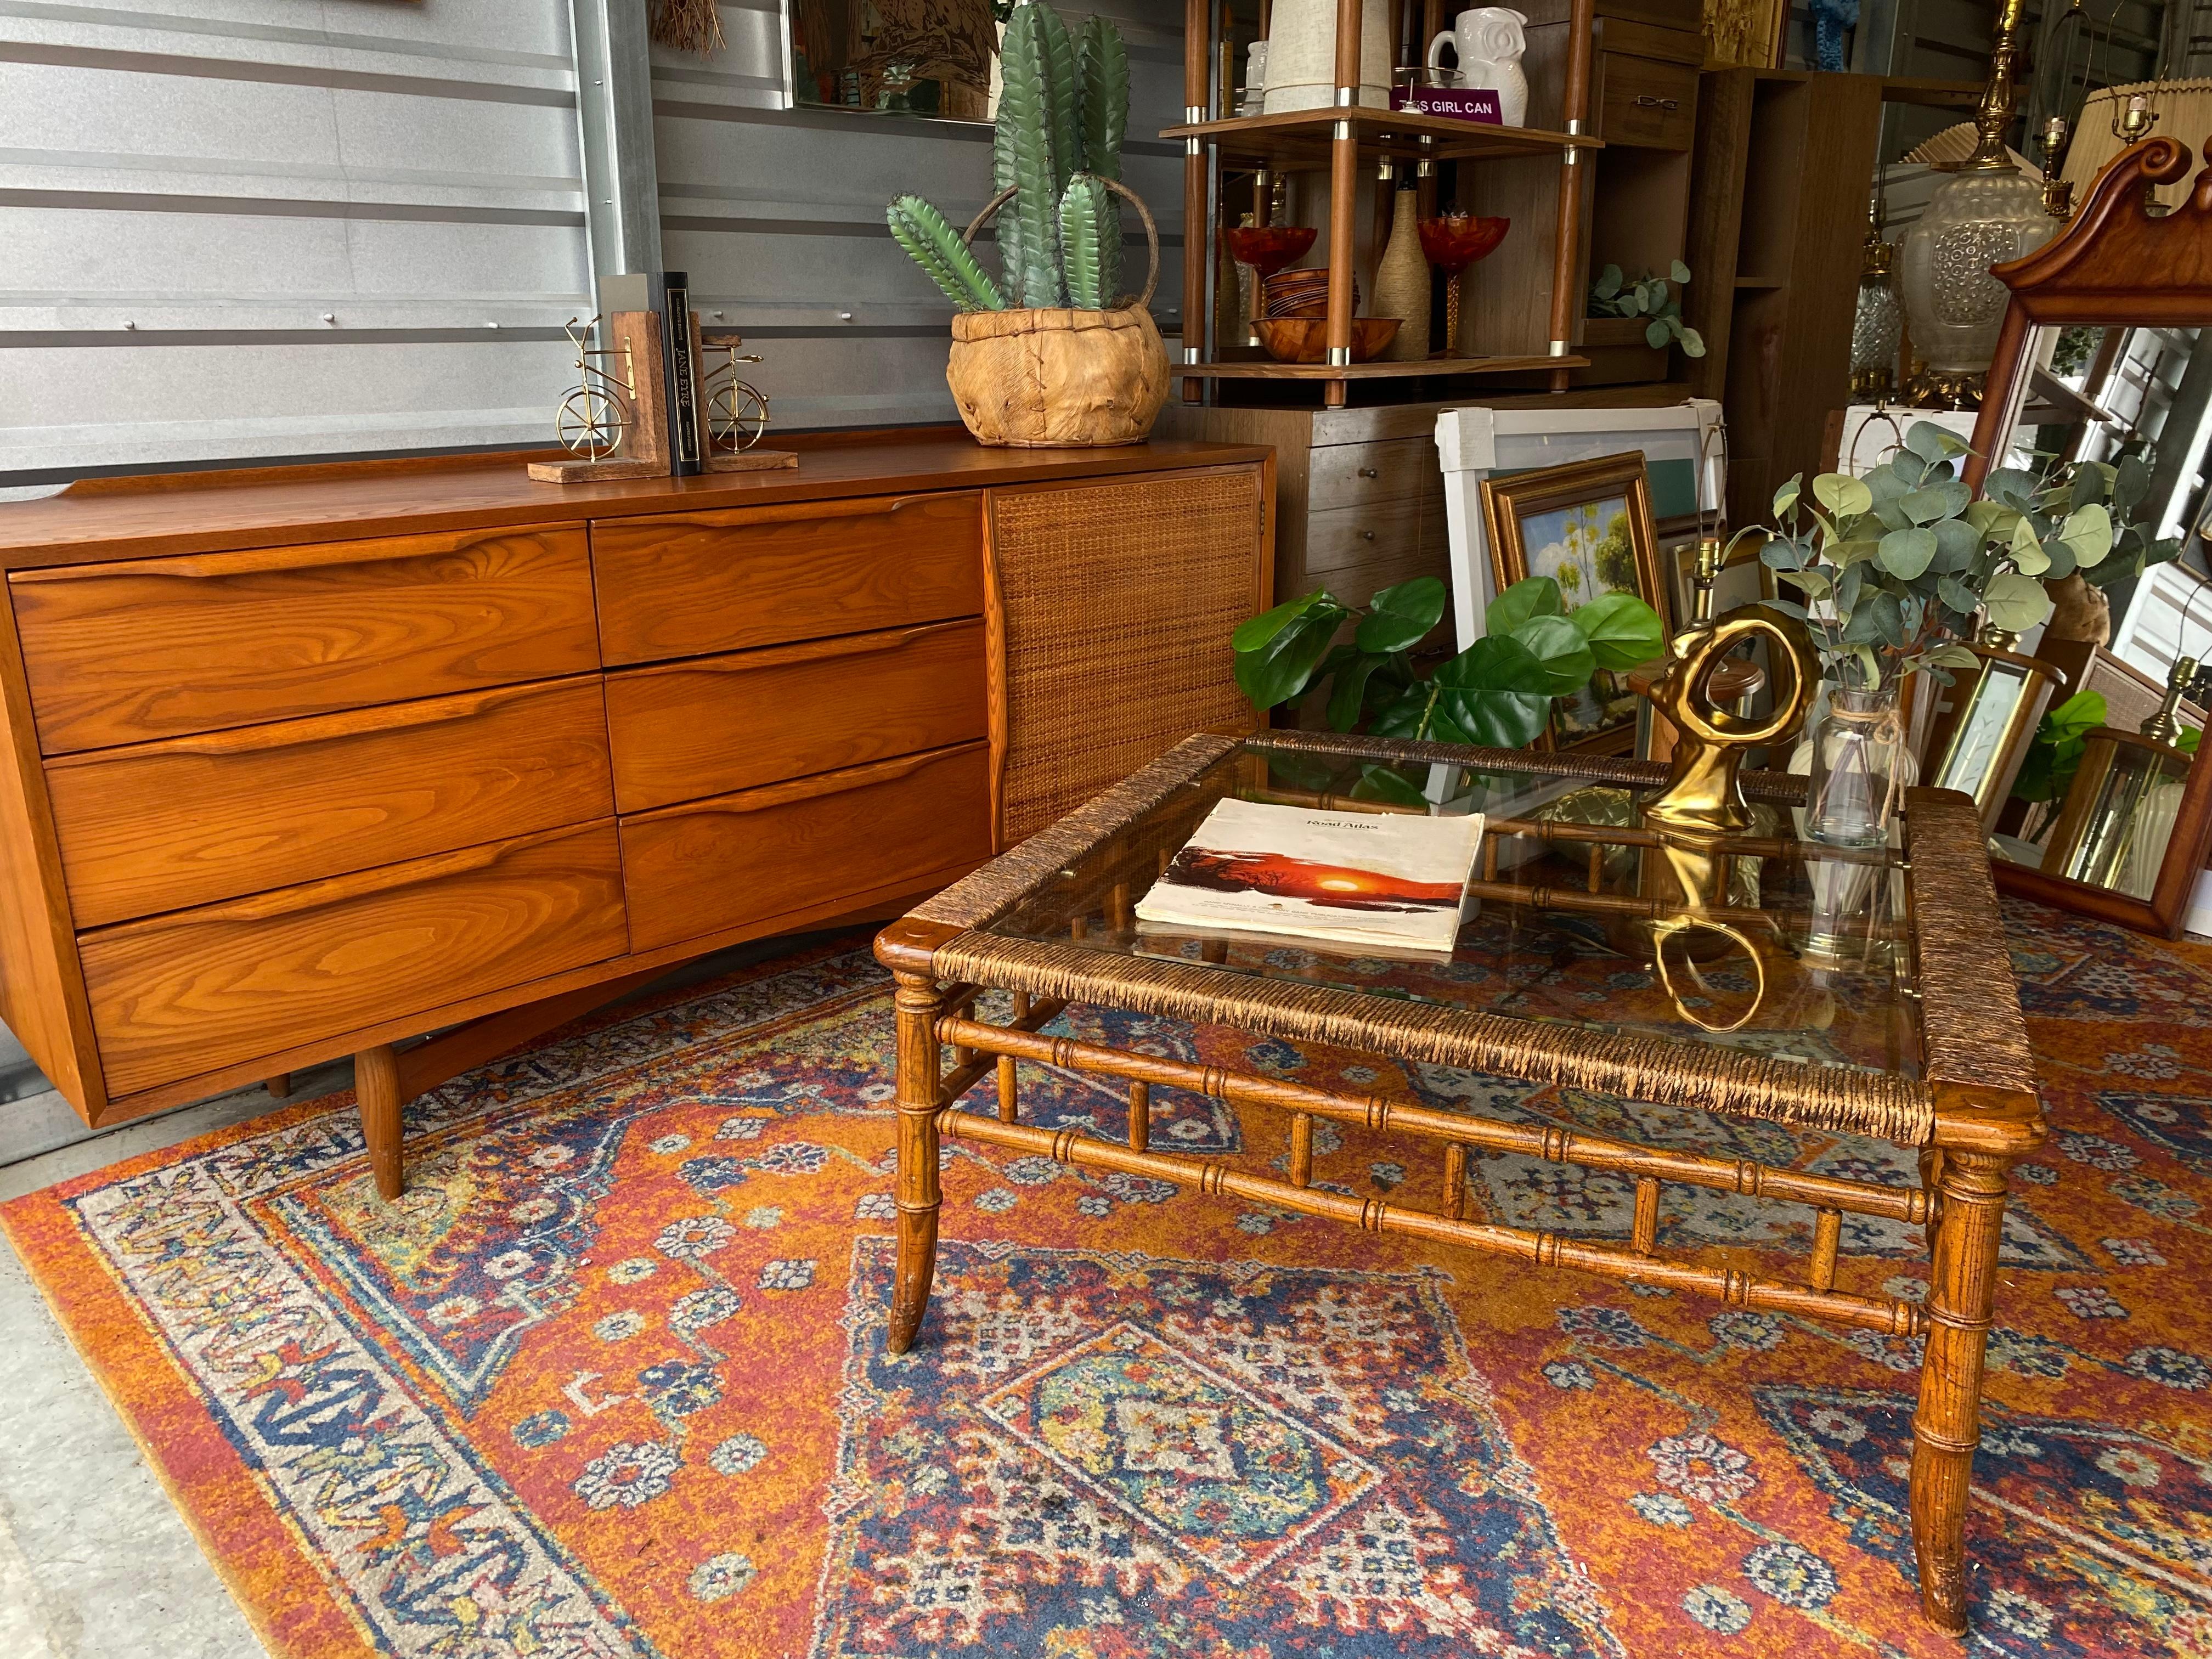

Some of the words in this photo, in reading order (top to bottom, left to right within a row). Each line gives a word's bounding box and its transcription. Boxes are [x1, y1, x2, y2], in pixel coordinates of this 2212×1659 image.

[1432, 101, 1462, 113] GIRL
[1465, 103, 1492, 114] CAN
[676, 348, 688, 376] JANE
[680, 379, 690, 407] EYRE
